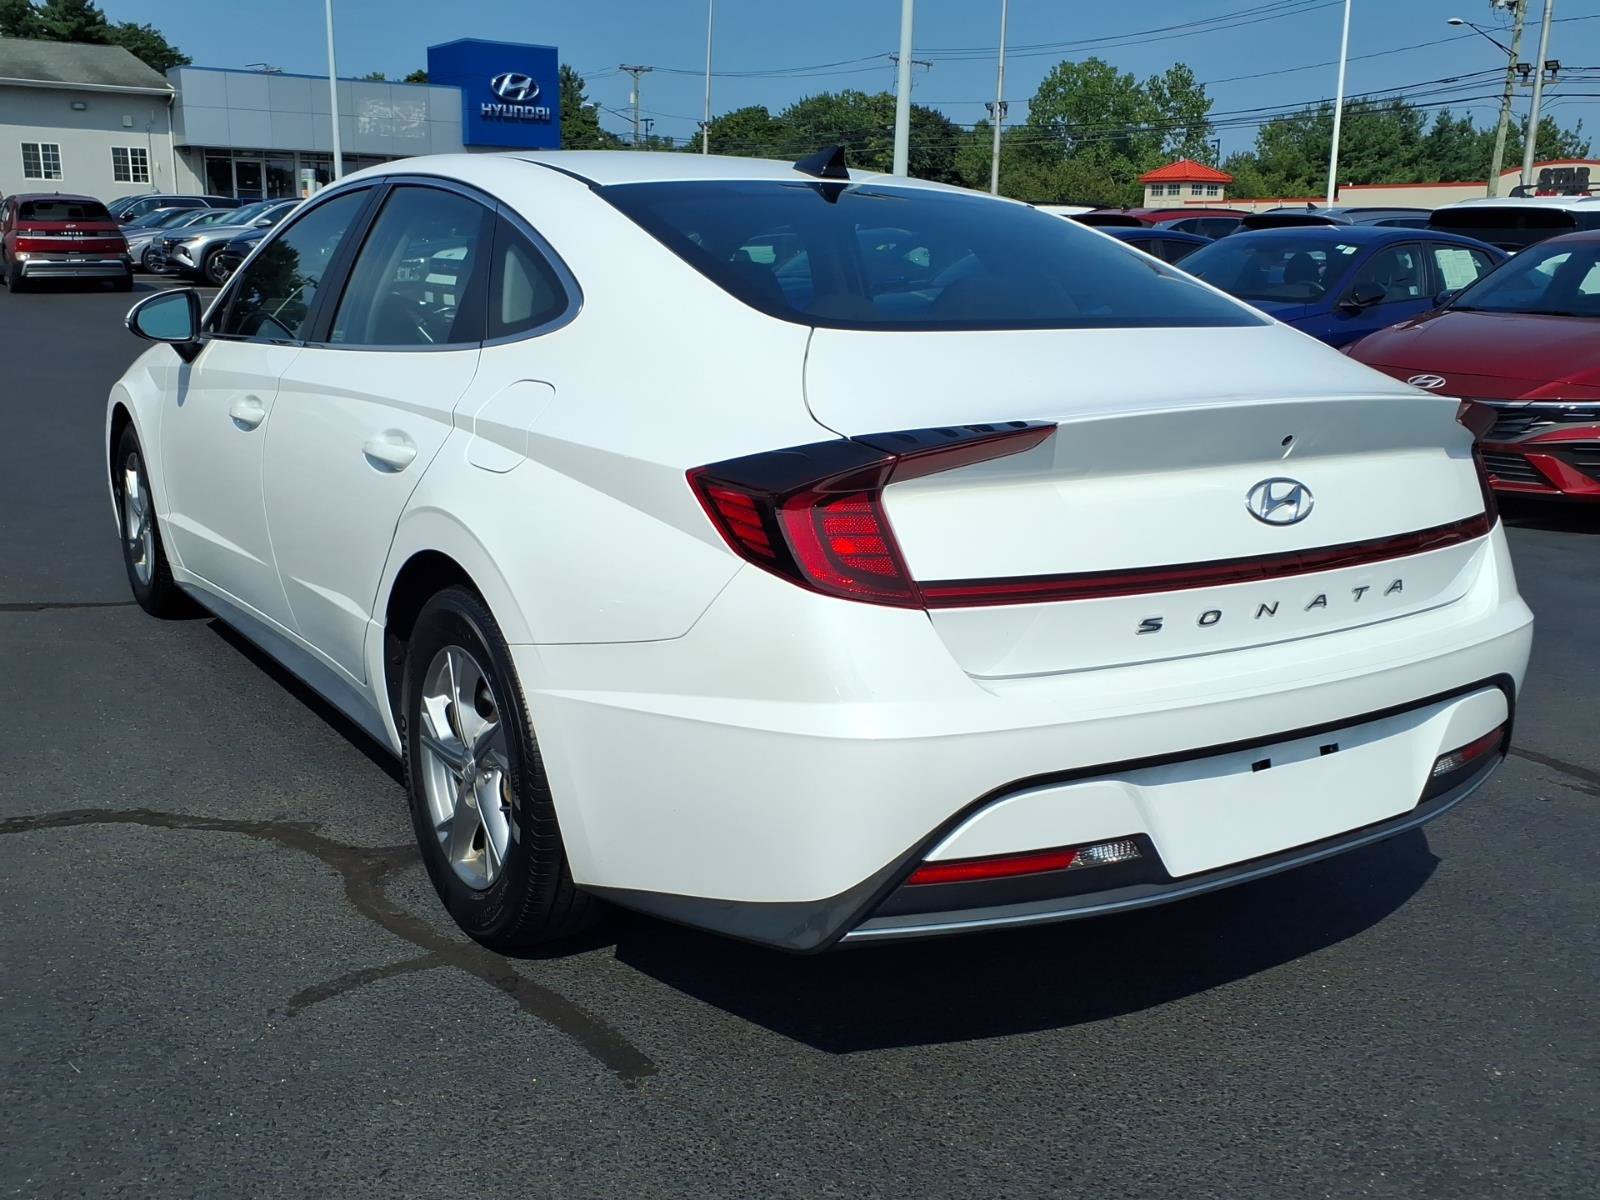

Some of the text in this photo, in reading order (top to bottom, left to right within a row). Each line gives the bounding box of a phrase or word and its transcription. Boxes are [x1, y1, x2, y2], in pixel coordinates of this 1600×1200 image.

[481, 103, 550, 120] HYUNDAI
[1538, 167, 1591, 190] STAR
[1136, 578, 1404, 635] SONATA
